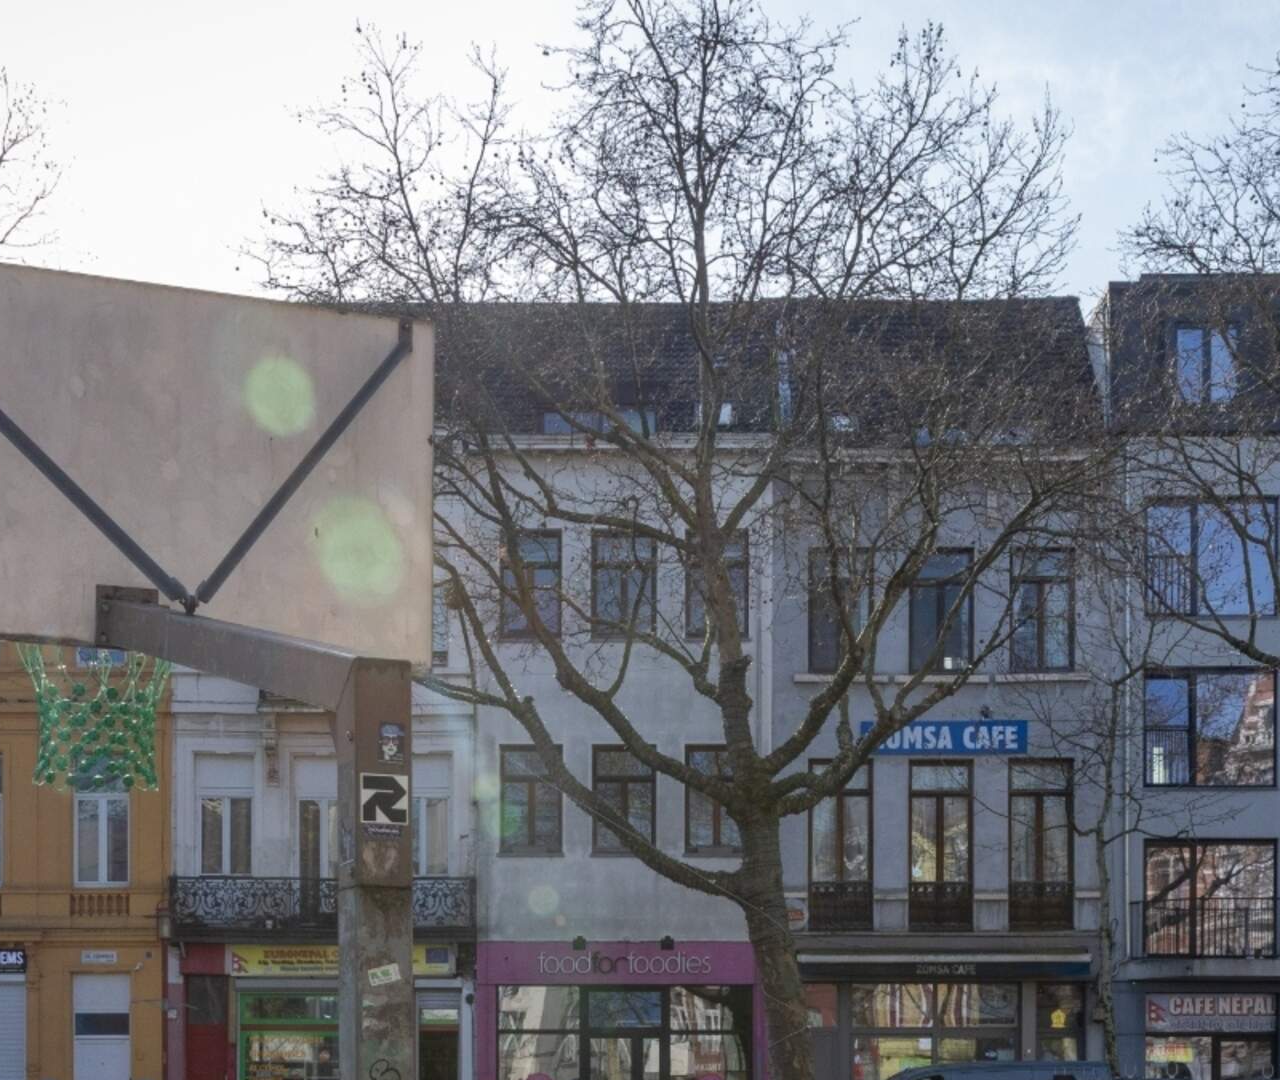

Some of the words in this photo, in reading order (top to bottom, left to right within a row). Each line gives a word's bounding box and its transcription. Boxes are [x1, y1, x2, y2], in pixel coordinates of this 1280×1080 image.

[868, 725, 953, 750] OMSA
[963, 725, 1018, 749] CAFE
[1168, 995, 1215, 1015] CAFE
[1218, 995, 1275, 1015] NEPAL
